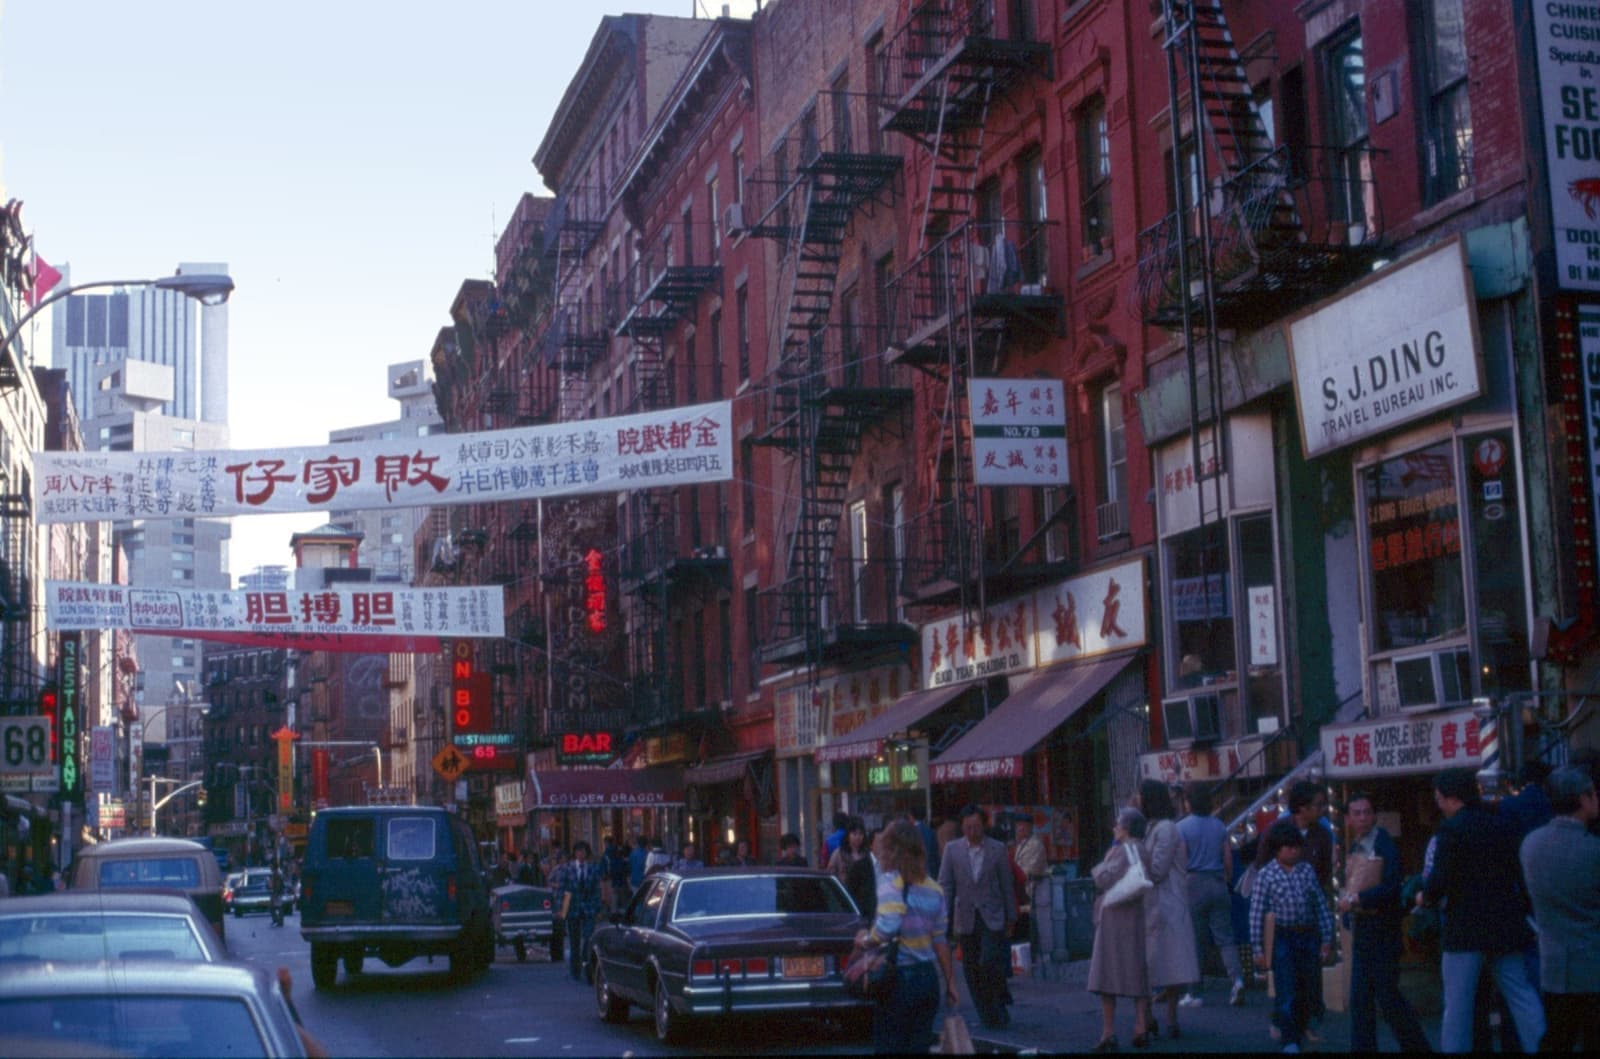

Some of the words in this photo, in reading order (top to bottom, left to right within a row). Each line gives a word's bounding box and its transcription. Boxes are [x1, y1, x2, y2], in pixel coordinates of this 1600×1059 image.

[1546, 3, 1600, 21] CHINE
[1321, 407, 1369, 437] TRAVEL
[1373, 383, 1425, 417] BUREAU
[1430, 372, 1459, 396] INC.
[251, 623, 297, 633] REVENGE
[303, 624, 314, 633] IN
[317, 624, 349, 633] HONG
[352, 624, 384, 633] KONG
[63, 640, 76, 792] RESTAURANT
[4, 724, 46, 767] 68
[474, 745, 496, 759] 65
[563, 732, 612, 754] BAR
[1376, 750, 1395, 769] RICE
[550, 793, 605, 804] GOLDEN
[611, 792, 665, 803] DRAGON
